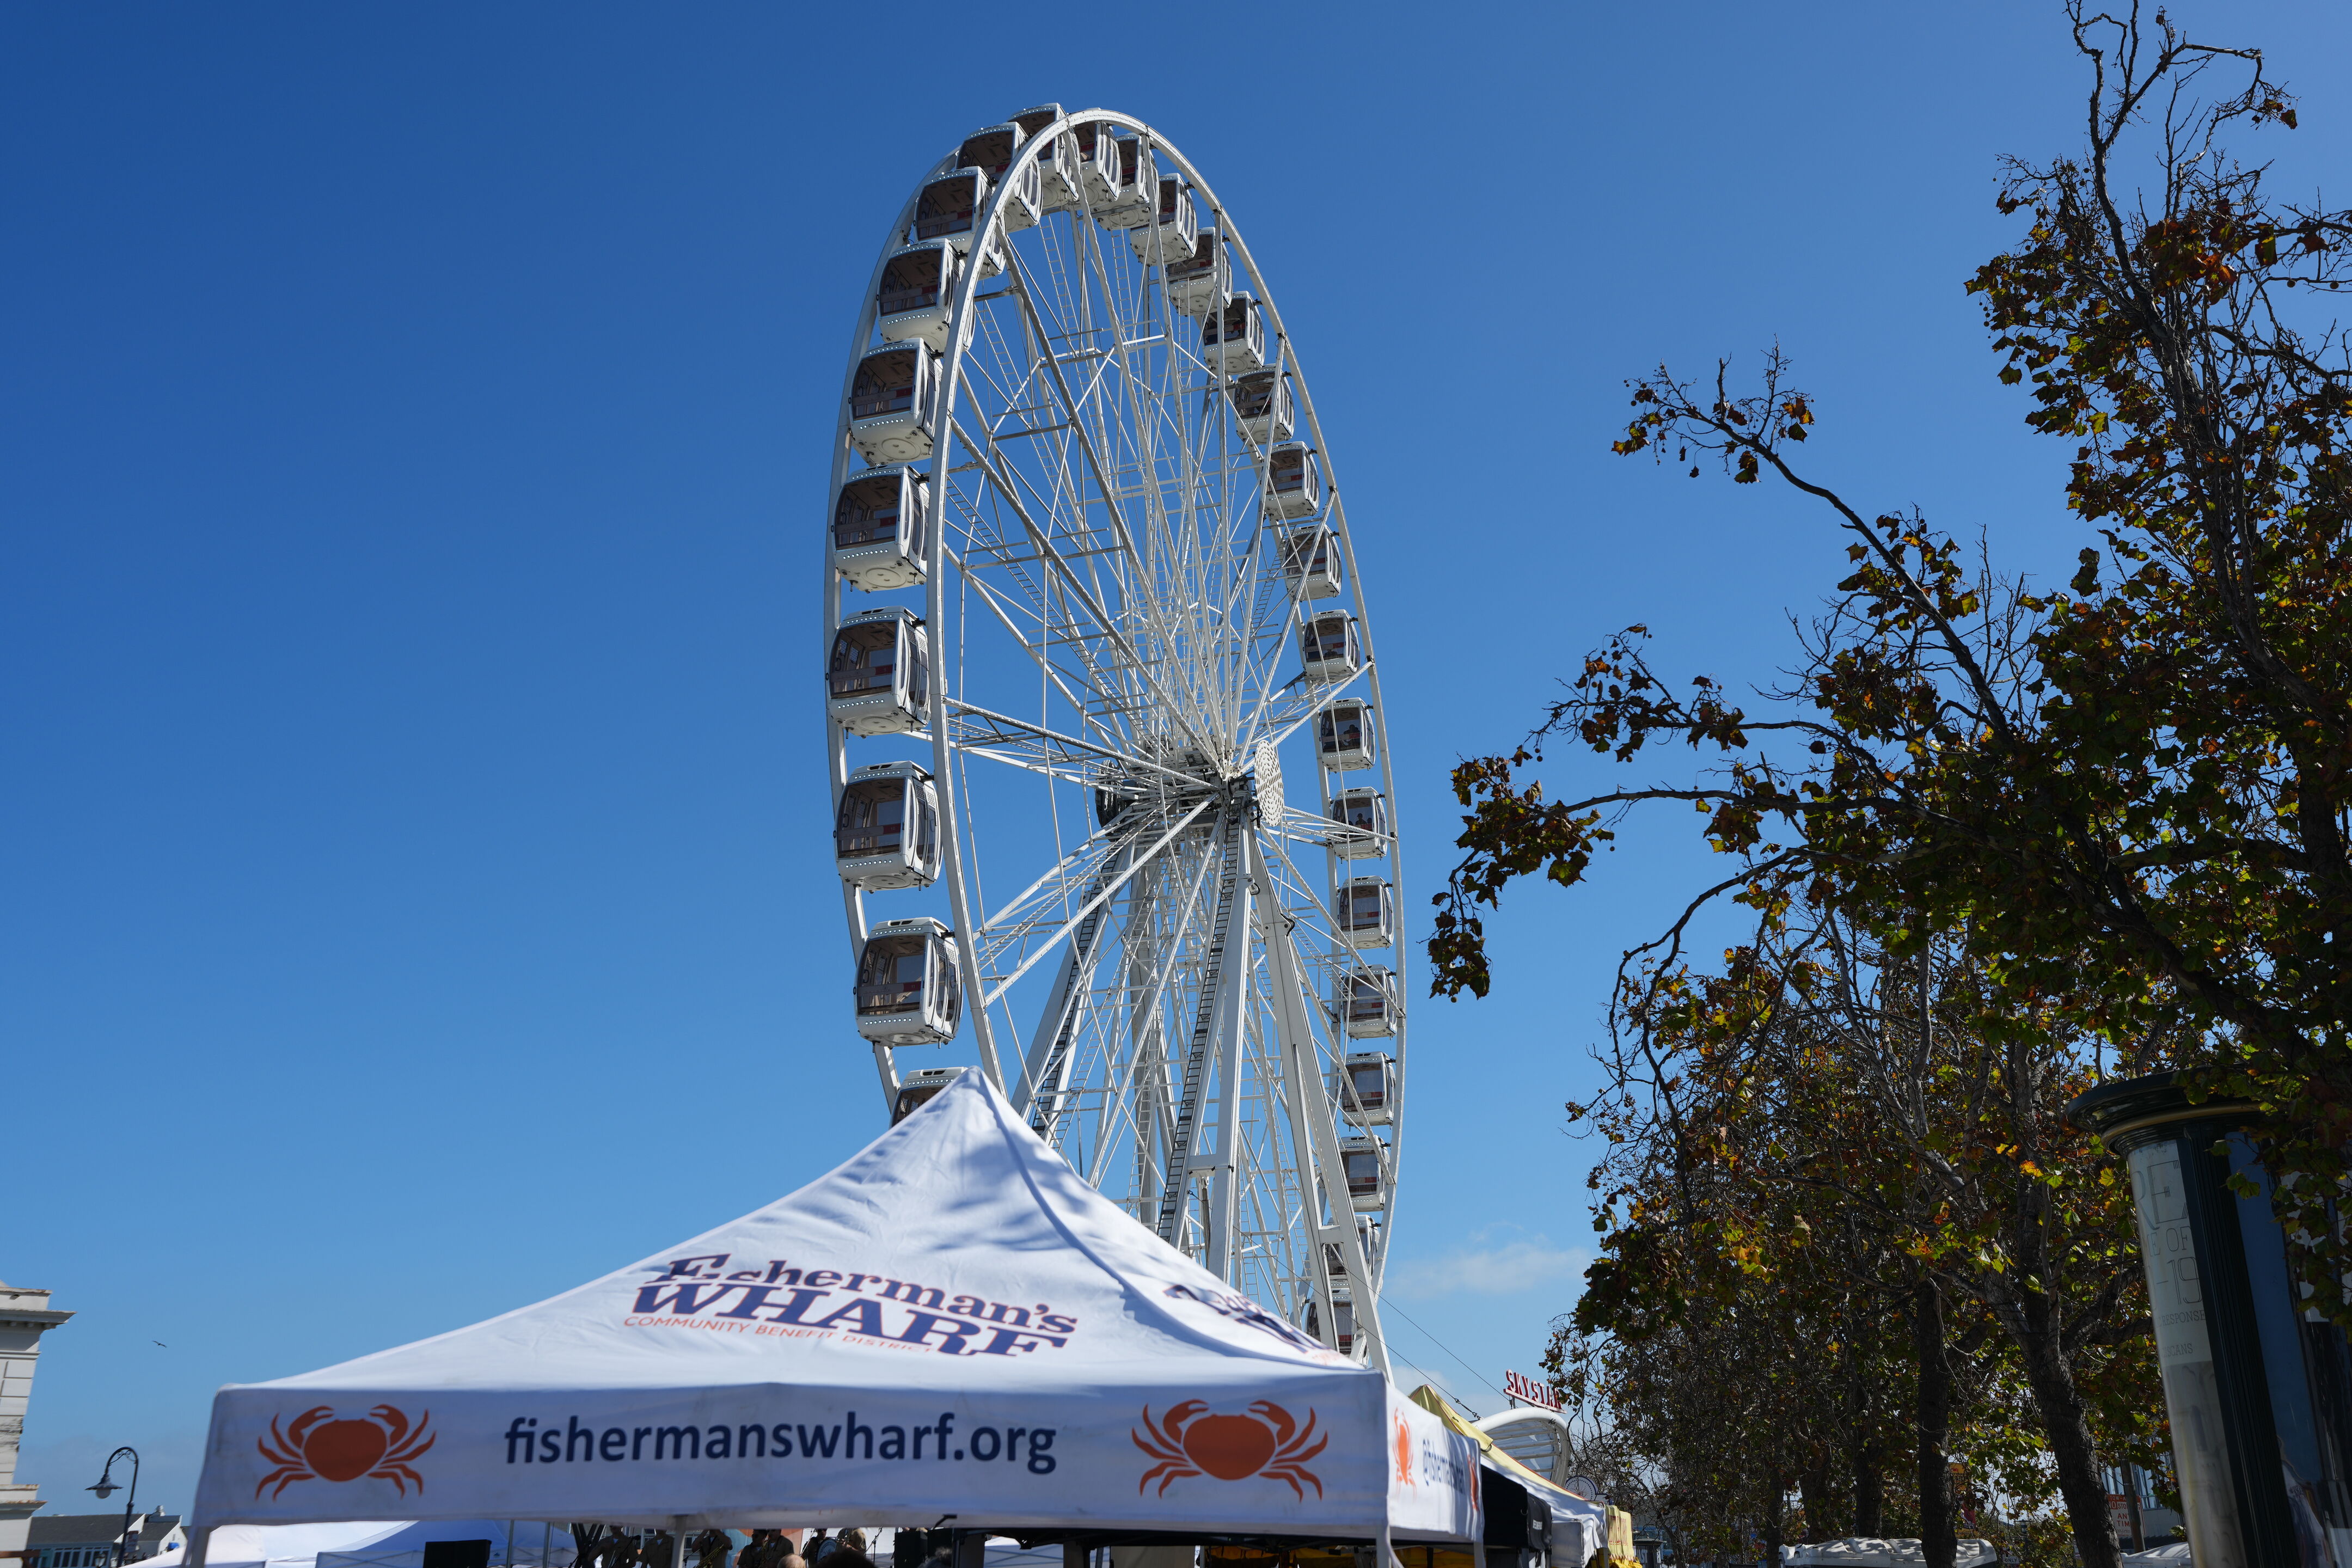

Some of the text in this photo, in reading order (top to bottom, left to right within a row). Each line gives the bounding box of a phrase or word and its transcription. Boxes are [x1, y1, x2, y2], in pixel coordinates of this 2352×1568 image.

[2166, 1226, 2191, 1252] OF
[2151, 1256, 2204, 1308] -19
[624, 1316, 935, 1352] COMMUNITY BENEFIT DISTRICT
[632, 1283, 1068, 1357] WHARF
[2161, 1309, 2206, 1326] RESPONSE
[504, 1412, 1057, 1475] fishermanswharf.org
